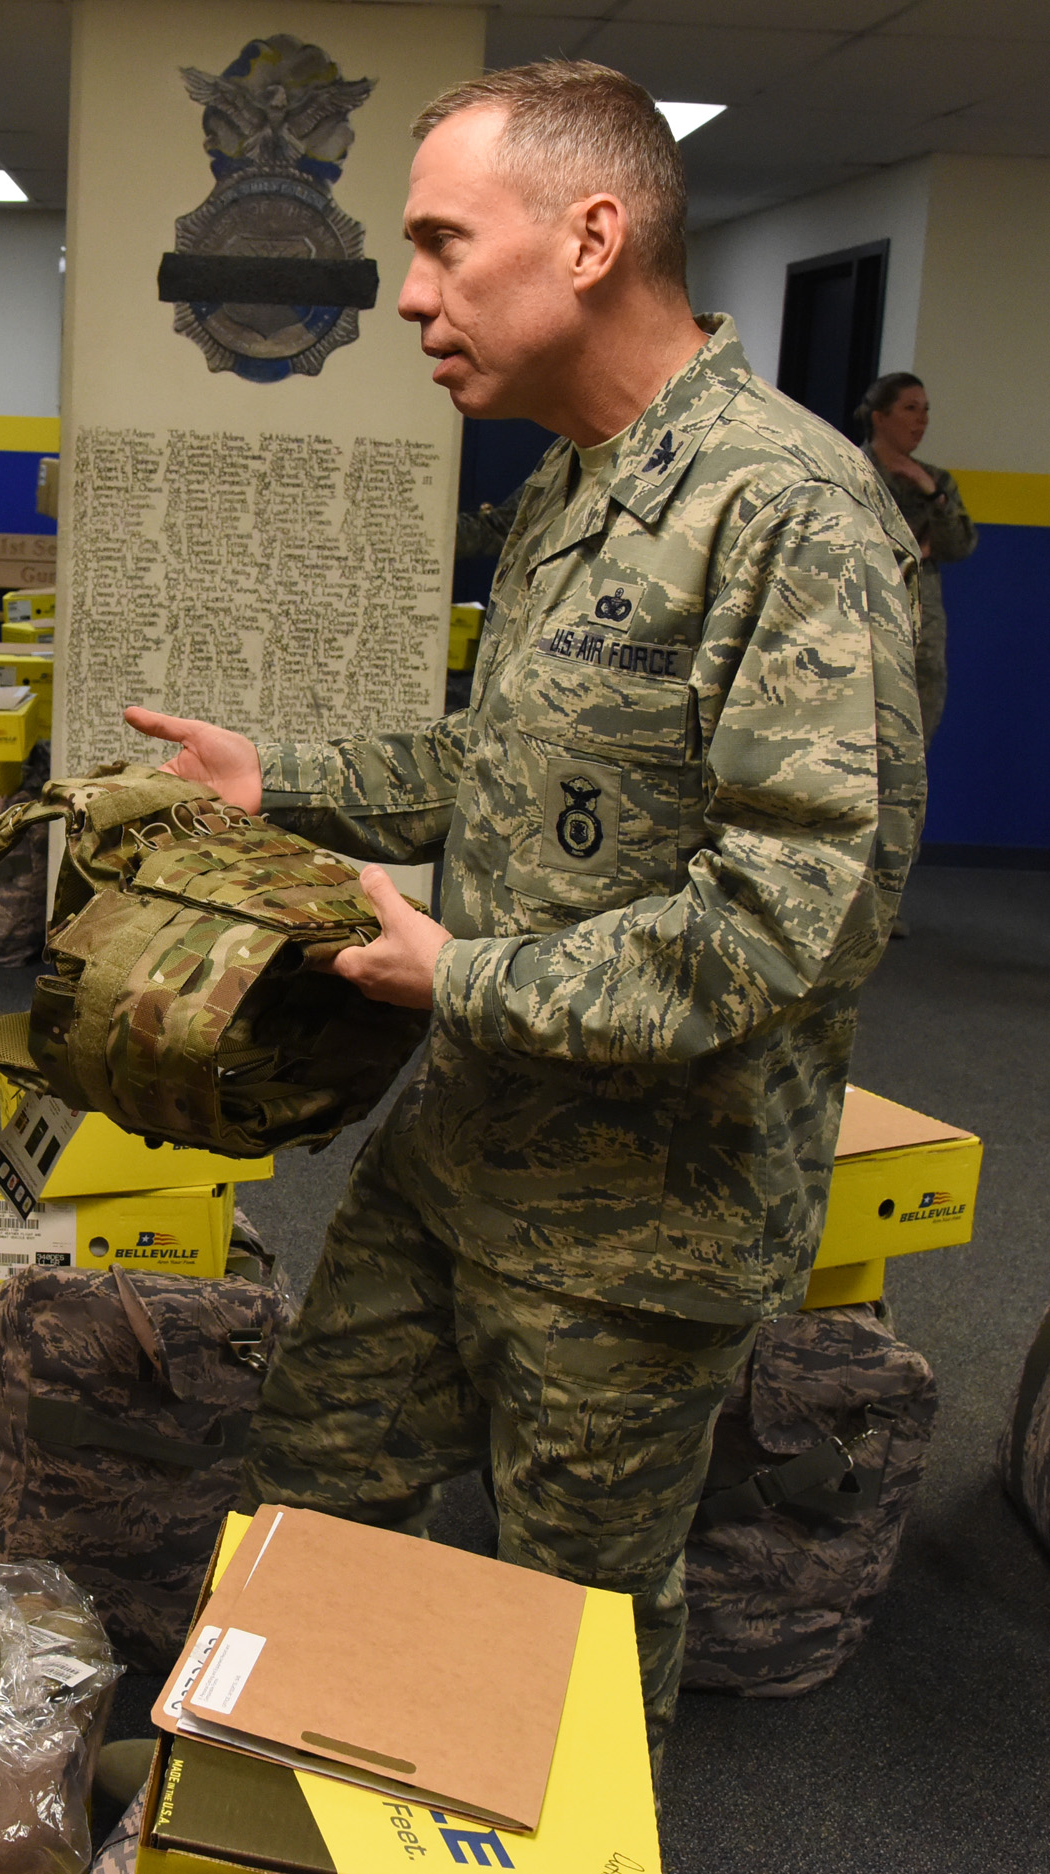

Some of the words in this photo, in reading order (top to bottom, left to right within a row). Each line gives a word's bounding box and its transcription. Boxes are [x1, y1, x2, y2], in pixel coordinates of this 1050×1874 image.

[576, 635, 604, 664] AIR
[608, 642, 679, 676] FORCE
[900, 1204, 966, 1223] BELLEVILLE
[114, 1249, 199, 1259] BELLEVILLE
[169, 1758, 184, 1784] MADE
[164, 1789, 174, 1802] THE
[157, 1801, 174, 1827] U.S.A.
[382, 1801, 427, 1861] Feet.
